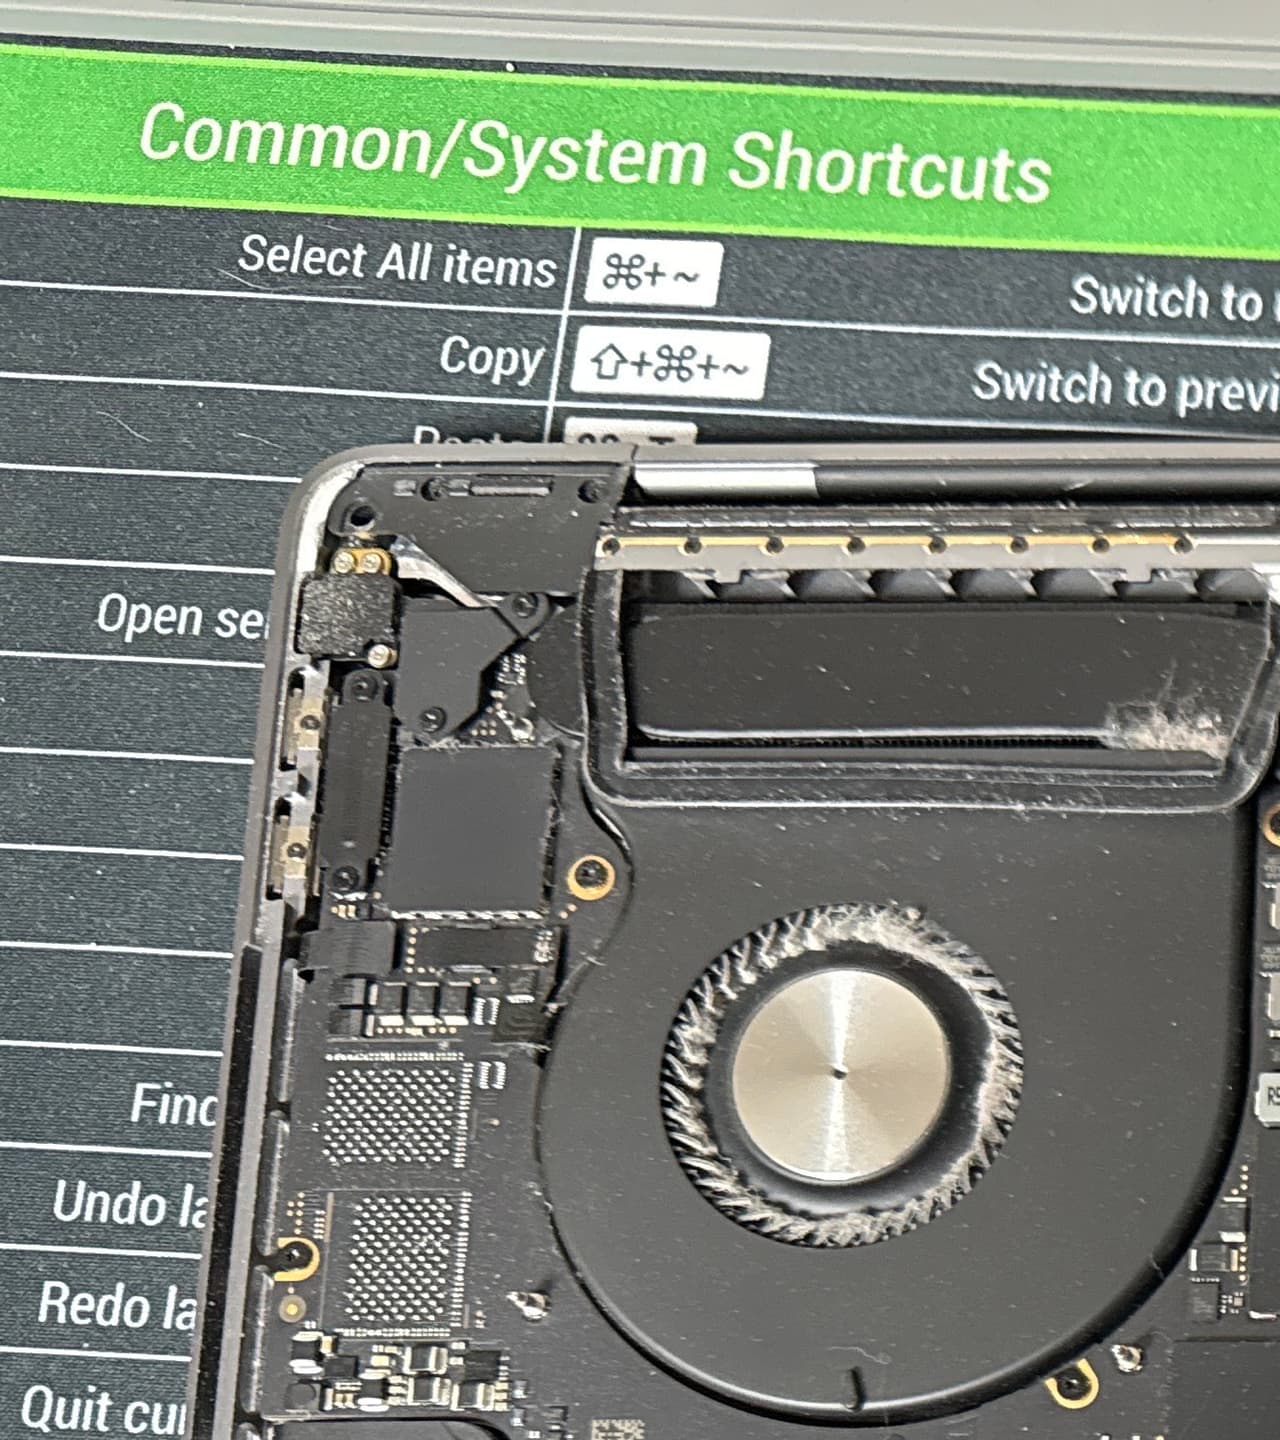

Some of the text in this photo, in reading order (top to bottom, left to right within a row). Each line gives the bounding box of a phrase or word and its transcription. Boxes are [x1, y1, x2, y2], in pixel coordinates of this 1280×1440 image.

[140, 101, 1052, 204] Common/System Shortcuts
[239, 234, 557, 289] Select All items
[1071, 275, 1209, 319] Switch
[1222, 285, 1262, 322] to
[441, 336, 545, 386] Copy
[973, 363, 1111, 405] Switch
[1125, 371, 1166, 408] to
[98, 594, 201, 644] Open
[52, 1179, 166, 1228] Undo
[37, 1279, 150, 1330] Redo
[21, 1384, 112, 1434] Quit
